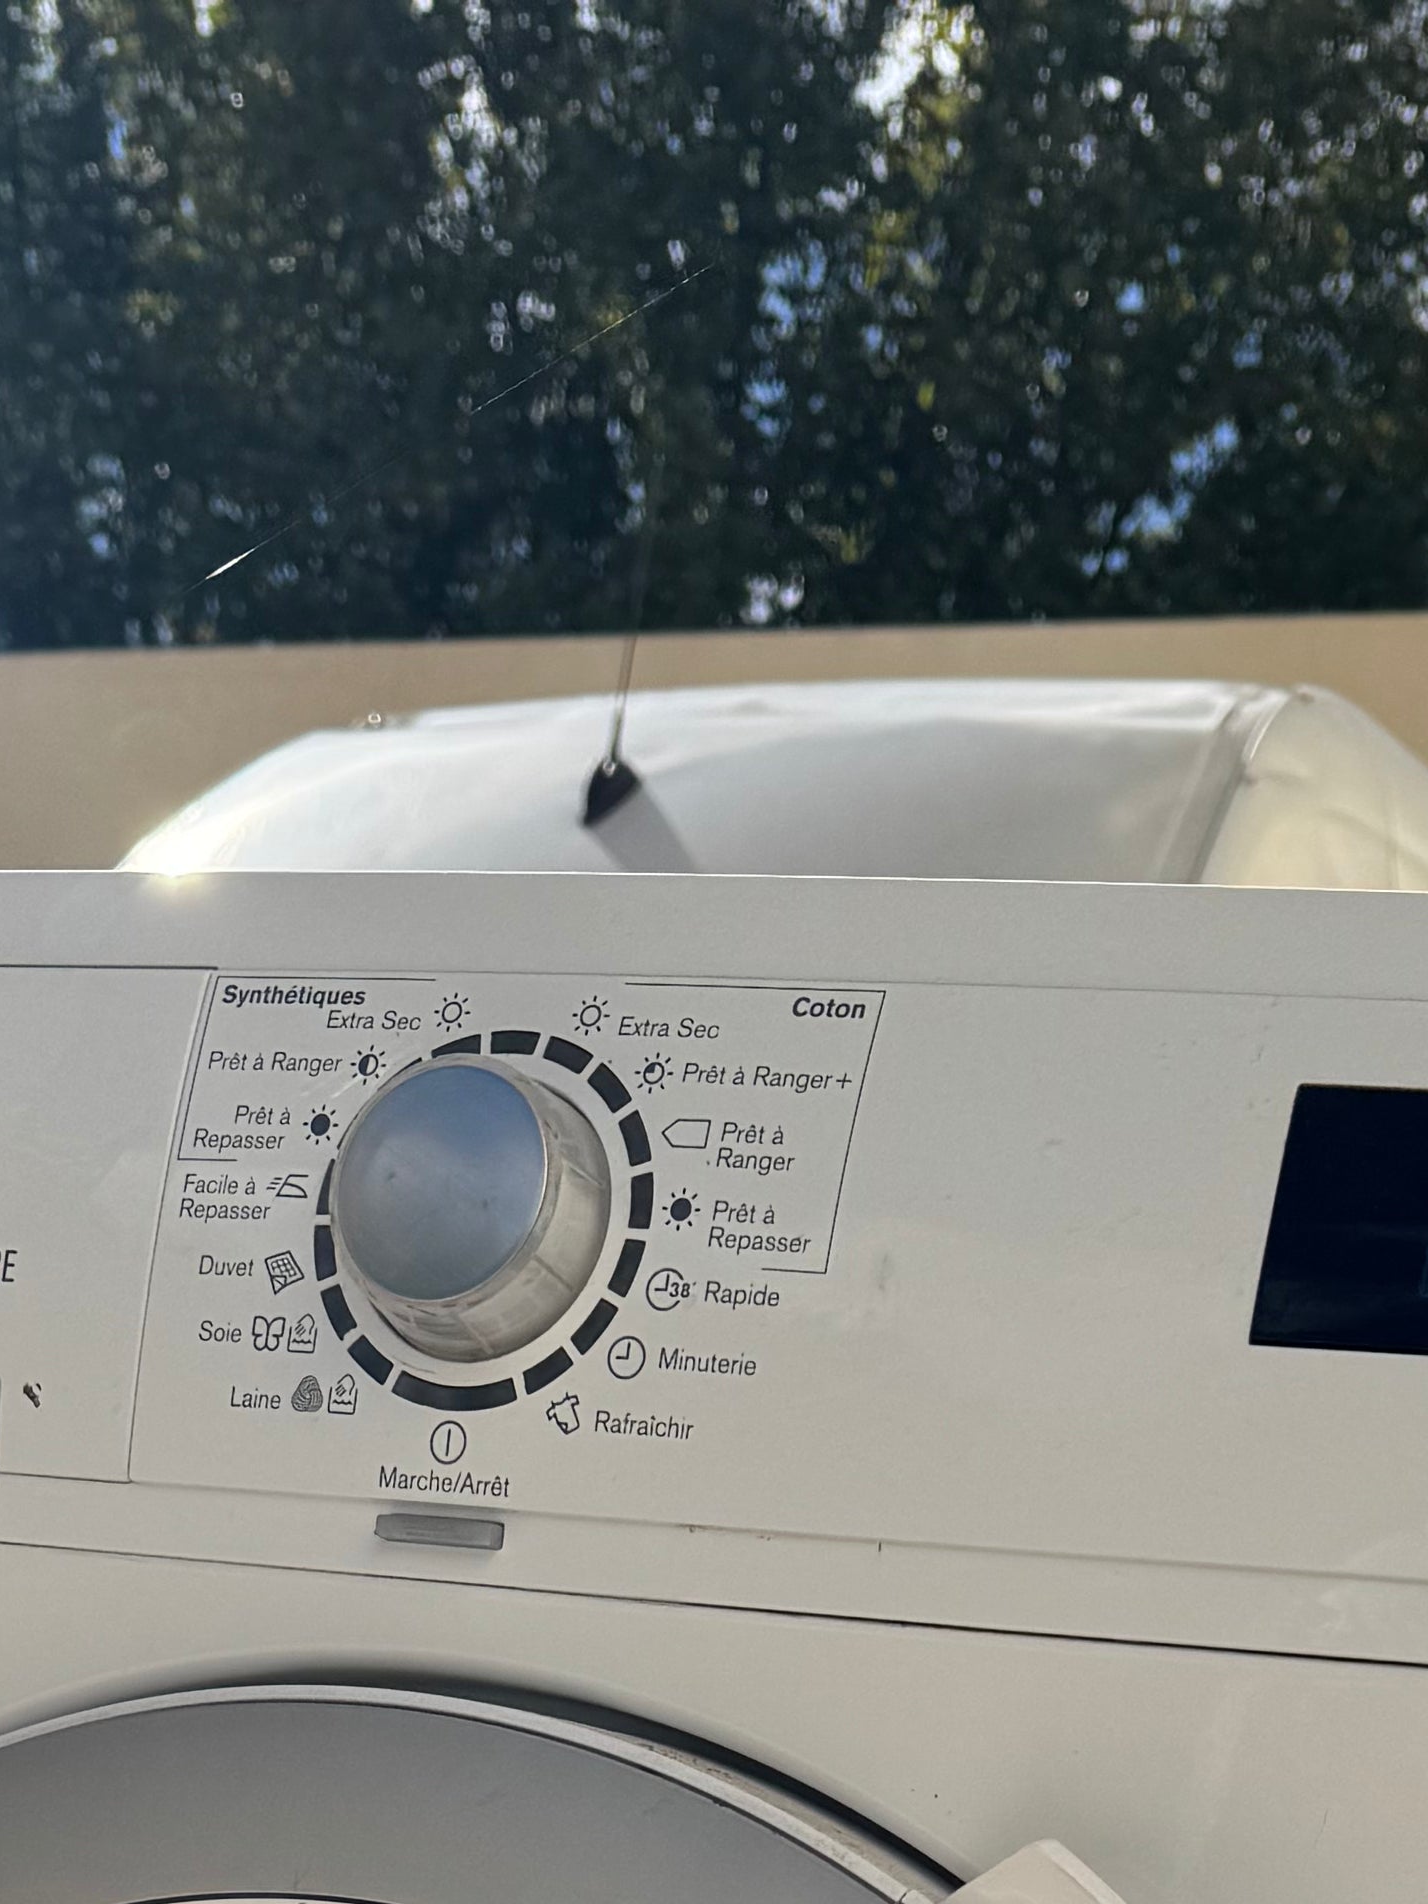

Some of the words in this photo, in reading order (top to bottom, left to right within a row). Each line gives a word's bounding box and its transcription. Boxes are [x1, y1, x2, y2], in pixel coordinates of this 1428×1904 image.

[222, 984, 366, 1008] Synthétiques
[792, 997, 866, 1019] Coton
[327, 1010, 374, 1030] Extra
[381, 1011, 421, 1030] Sec
[618, 1016, 669, 1037] Extra
[677, 1017, 720, 1039] Sec
[208, 1051, 247, 1070] Prêt
[253, 1054, 263, 1070] à
[272, 1052, 342, 1076] Ranger
[682, 1063, 725, 1084] Prêt
[732, 1067, 745, 1085] à
[235, 1105, 274, 1125] Prêt
[280, 1107, 290, 1125] à
[193, 1128, 285, 1153] Repasser
[721, 1122, 765, 1144] Prêt
[772, 1126, 784, 1144] à
[716, 1147, 795, 1175] Ranger
[183, 1174, 238, 1194] Facile
[245, 1177, 256, 1195] à
[179, 1198, 270, 1223] Repasser
[712, 1200, 756, 1224] Prêt
[763, 1204, 775, 1224] à
[708, 1226, 811, 1255] Repasser
[199, 1255, 253, 1276] Duvet
[705, 1281, 780, 1309] Rapide
[199, 1320, 242, 1343] Soie
[659, 1347, 757, 1375] Minuterie
[230, 1386, 281, 1409] Laine
[595, 1410, 694, 1439] Rafraîchir
[379, 1466, 509, 1498] Marche/Arrêt
